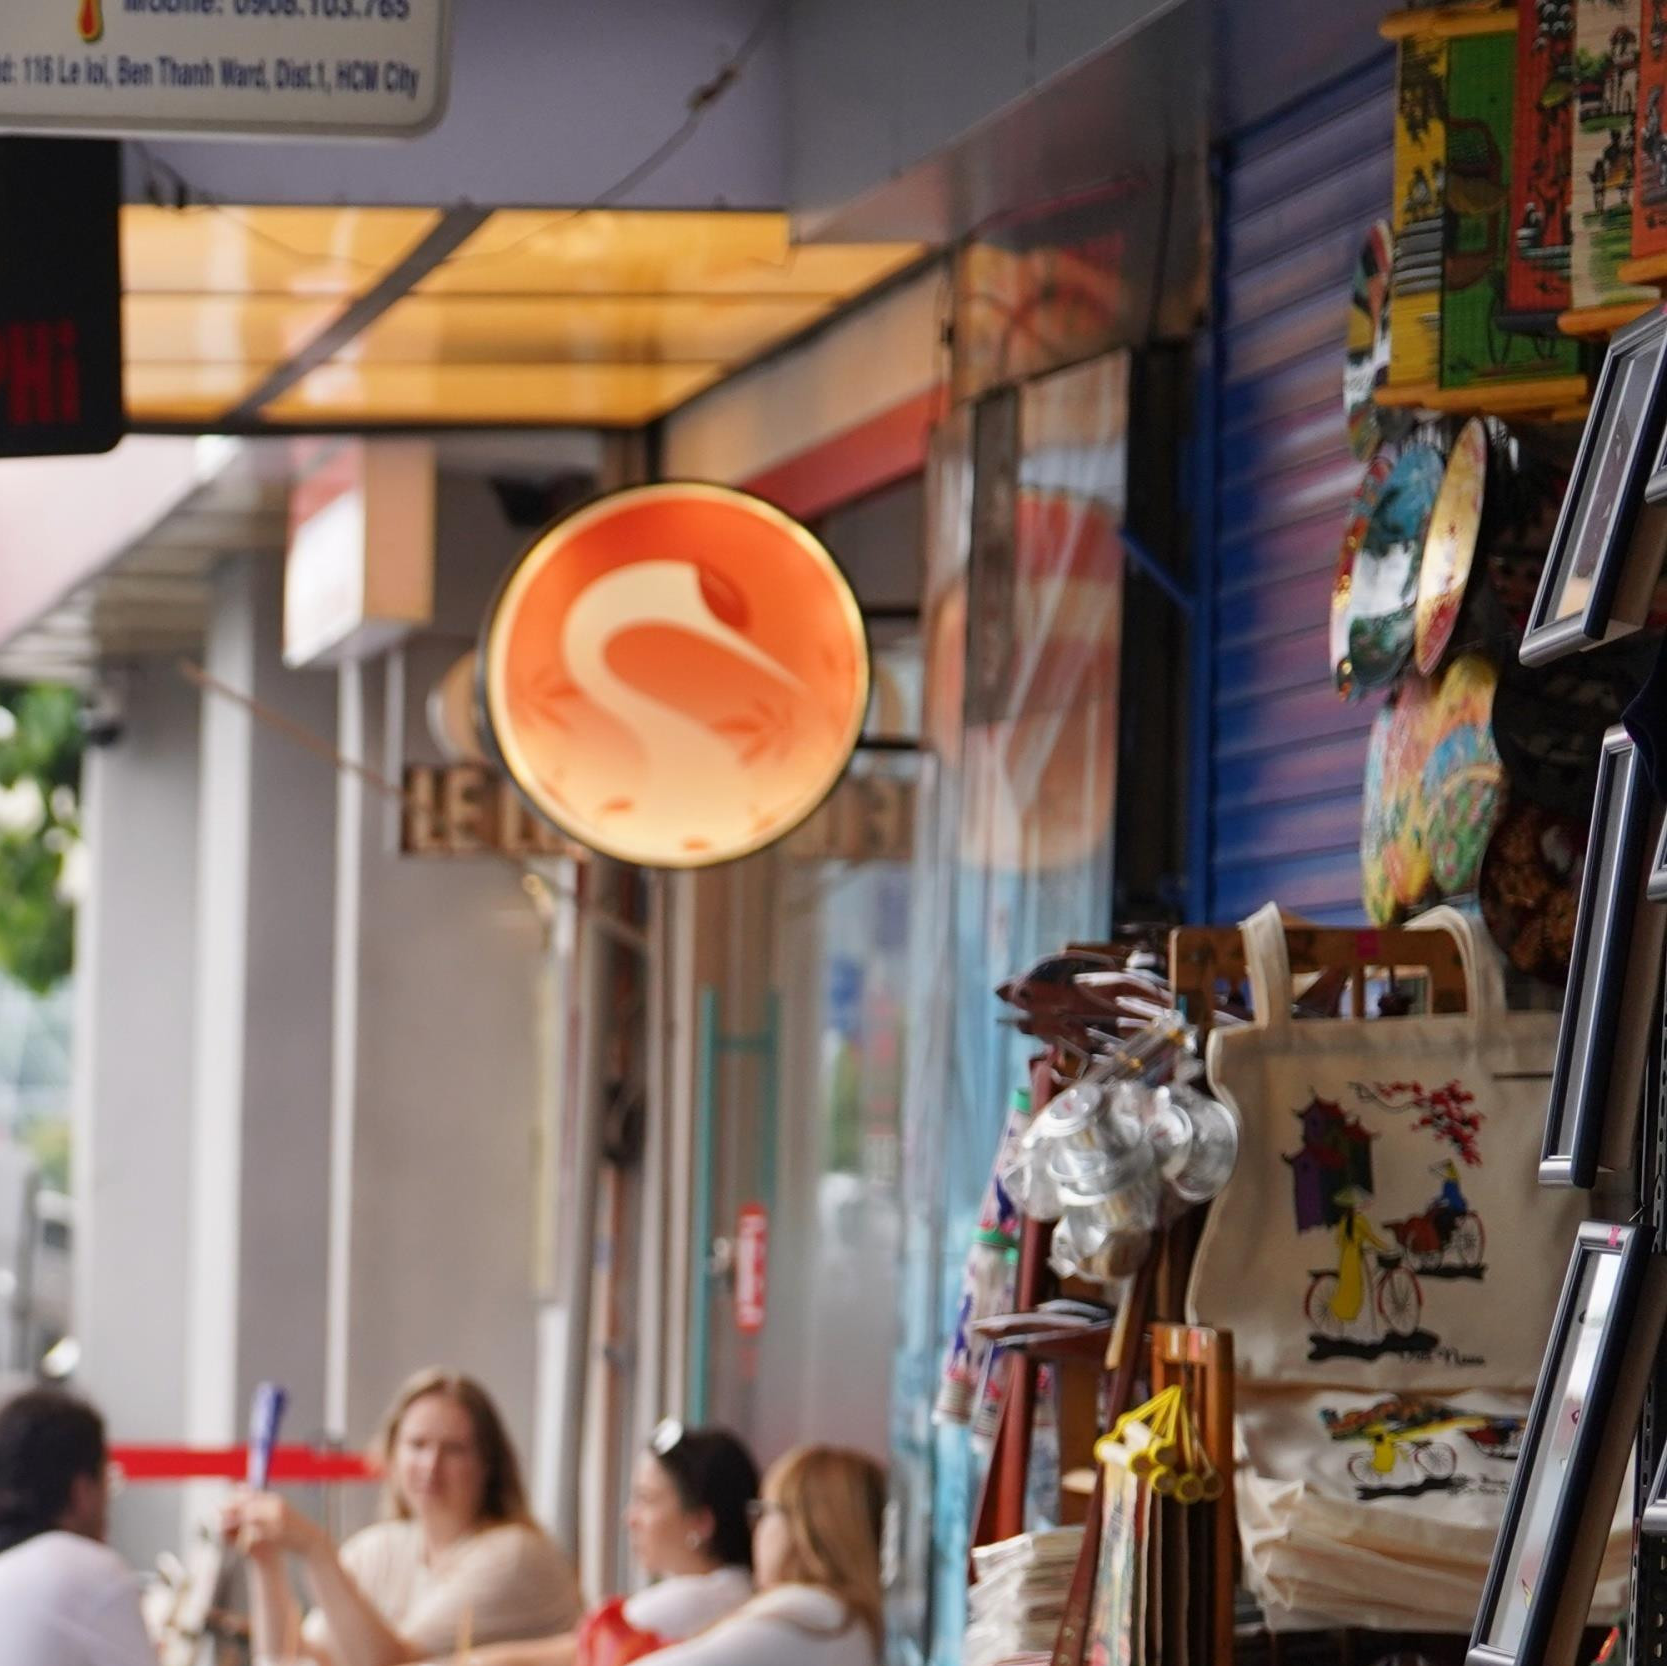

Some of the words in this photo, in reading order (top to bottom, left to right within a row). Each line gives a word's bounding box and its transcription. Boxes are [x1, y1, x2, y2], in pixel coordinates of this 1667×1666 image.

[118, 55, 153, 86] Ben
[159, 56, 214, 87] Thanh
[336, 60, 379, 93] HCM
[384, 60, 420, 101] City
